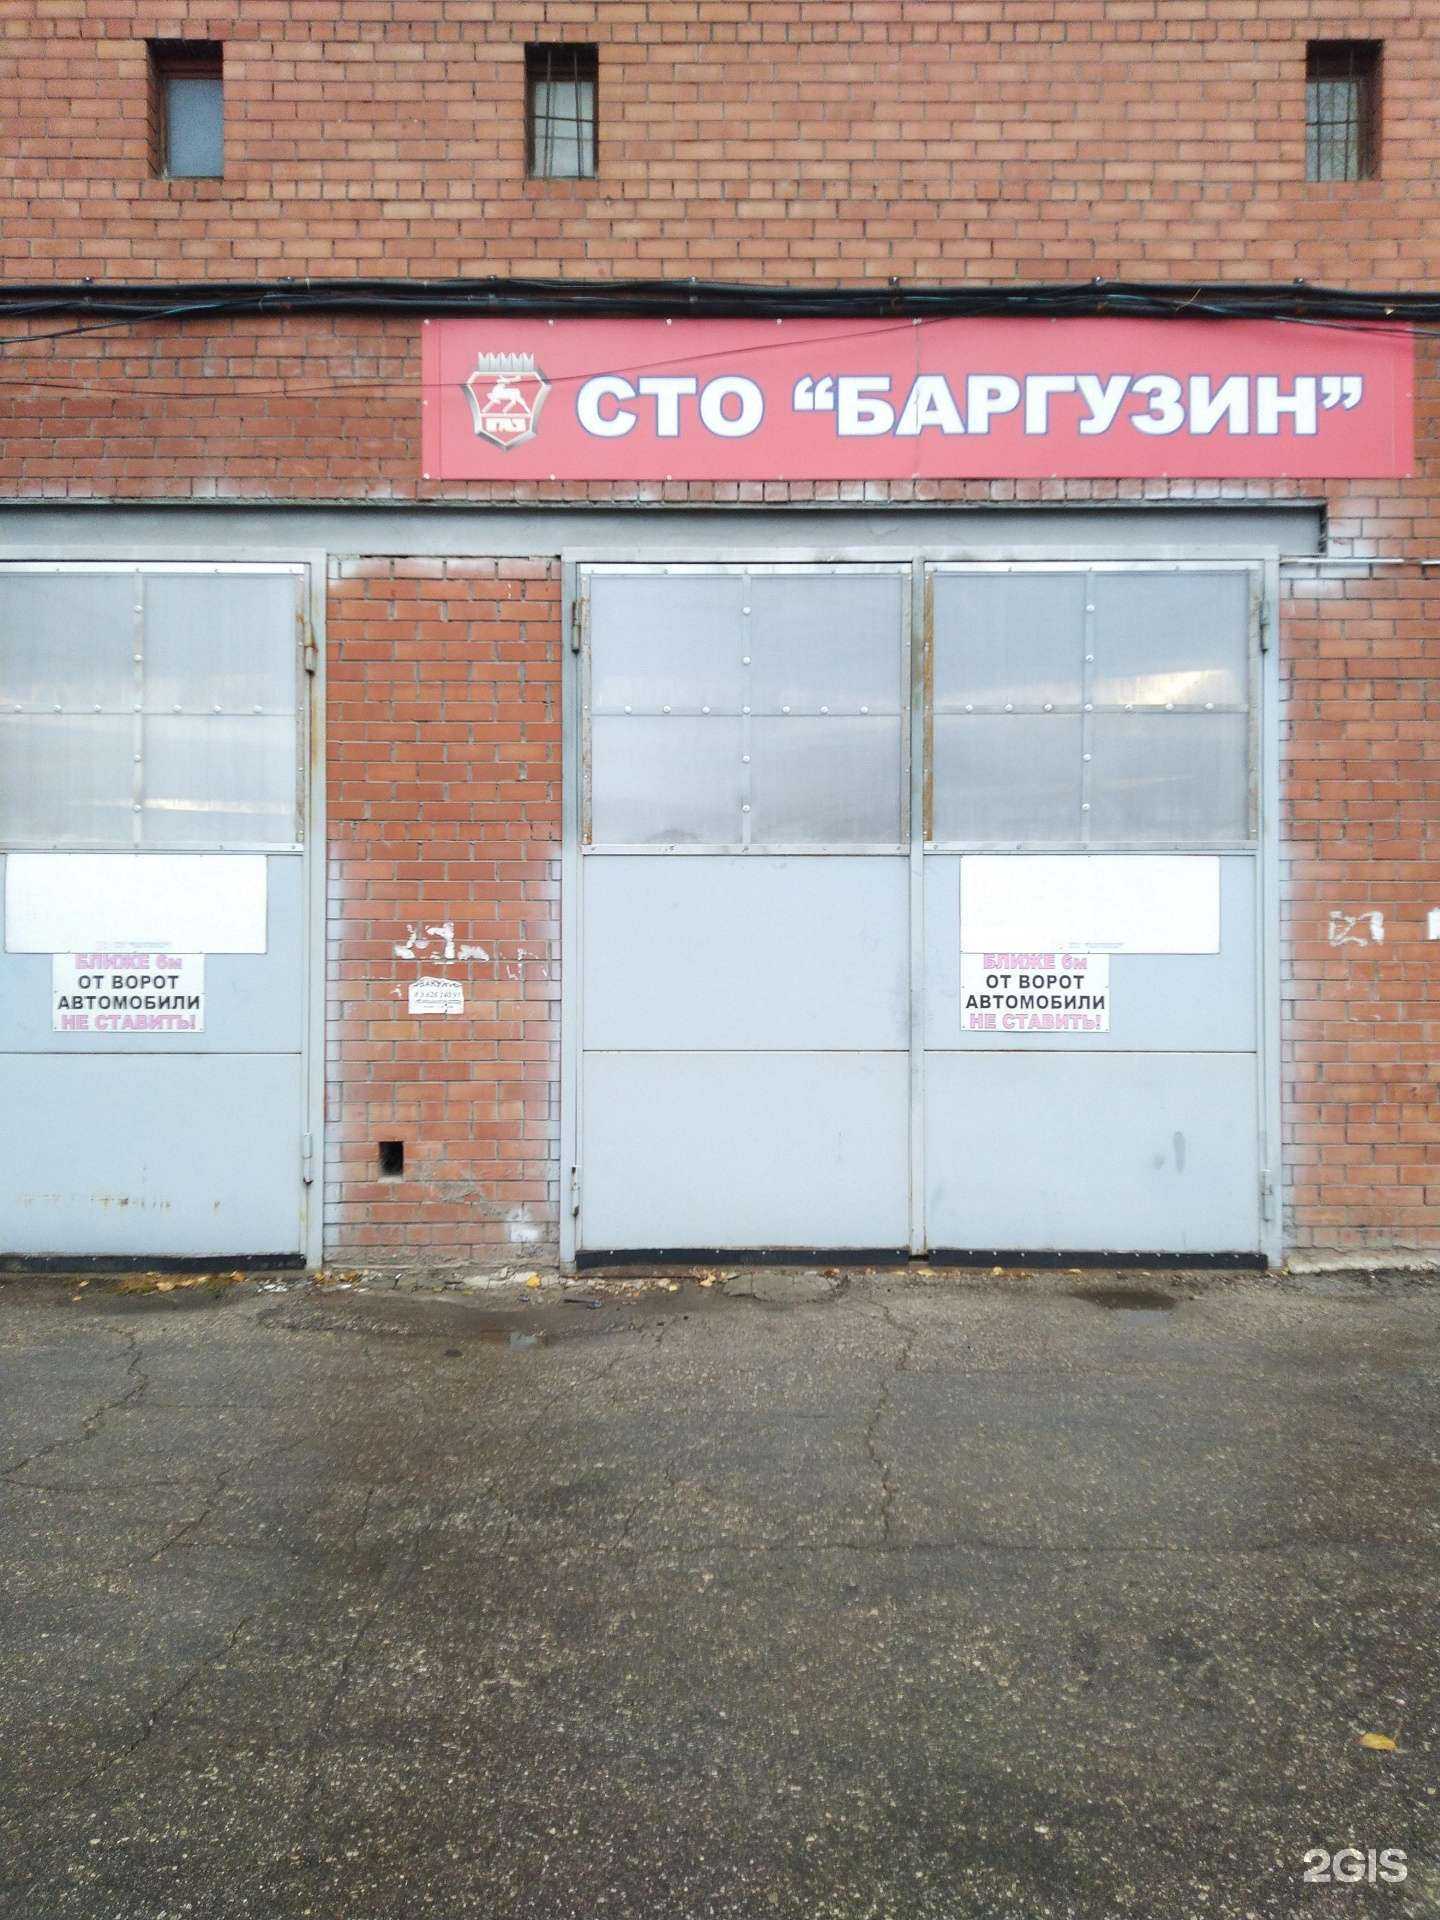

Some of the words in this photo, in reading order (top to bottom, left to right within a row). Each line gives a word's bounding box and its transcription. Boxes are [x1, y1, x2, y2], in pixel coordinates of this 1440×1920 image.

[576, 375, 765, 437] СТО
[75, 953, 149, 969] БЛИЖЕ
[983, 953, 1055, 969] БЛИЖЕ
[1062, 954, 1088, 969] 6м
[78, 976, 104, 989] ОТ
[112, 976, 179, 989] ВОРОТ
[986, 975, 1011, 988] ОТ
[1019, 975, 1085, 988] ВОРОТ
[57, 996, 200, 1010] АВТОМОБИЛИ
[966, 995, 1105, 1010] АВТОМОБИЛИ
[61, 1015, 89, 1030] НЕ
[95, 1015, 196, 1030] СТАВИТЬ!
[969, 1014, 996, 1029] НЕ
[1002, 1014, 1102, 1030] СТАВИТЬ!
